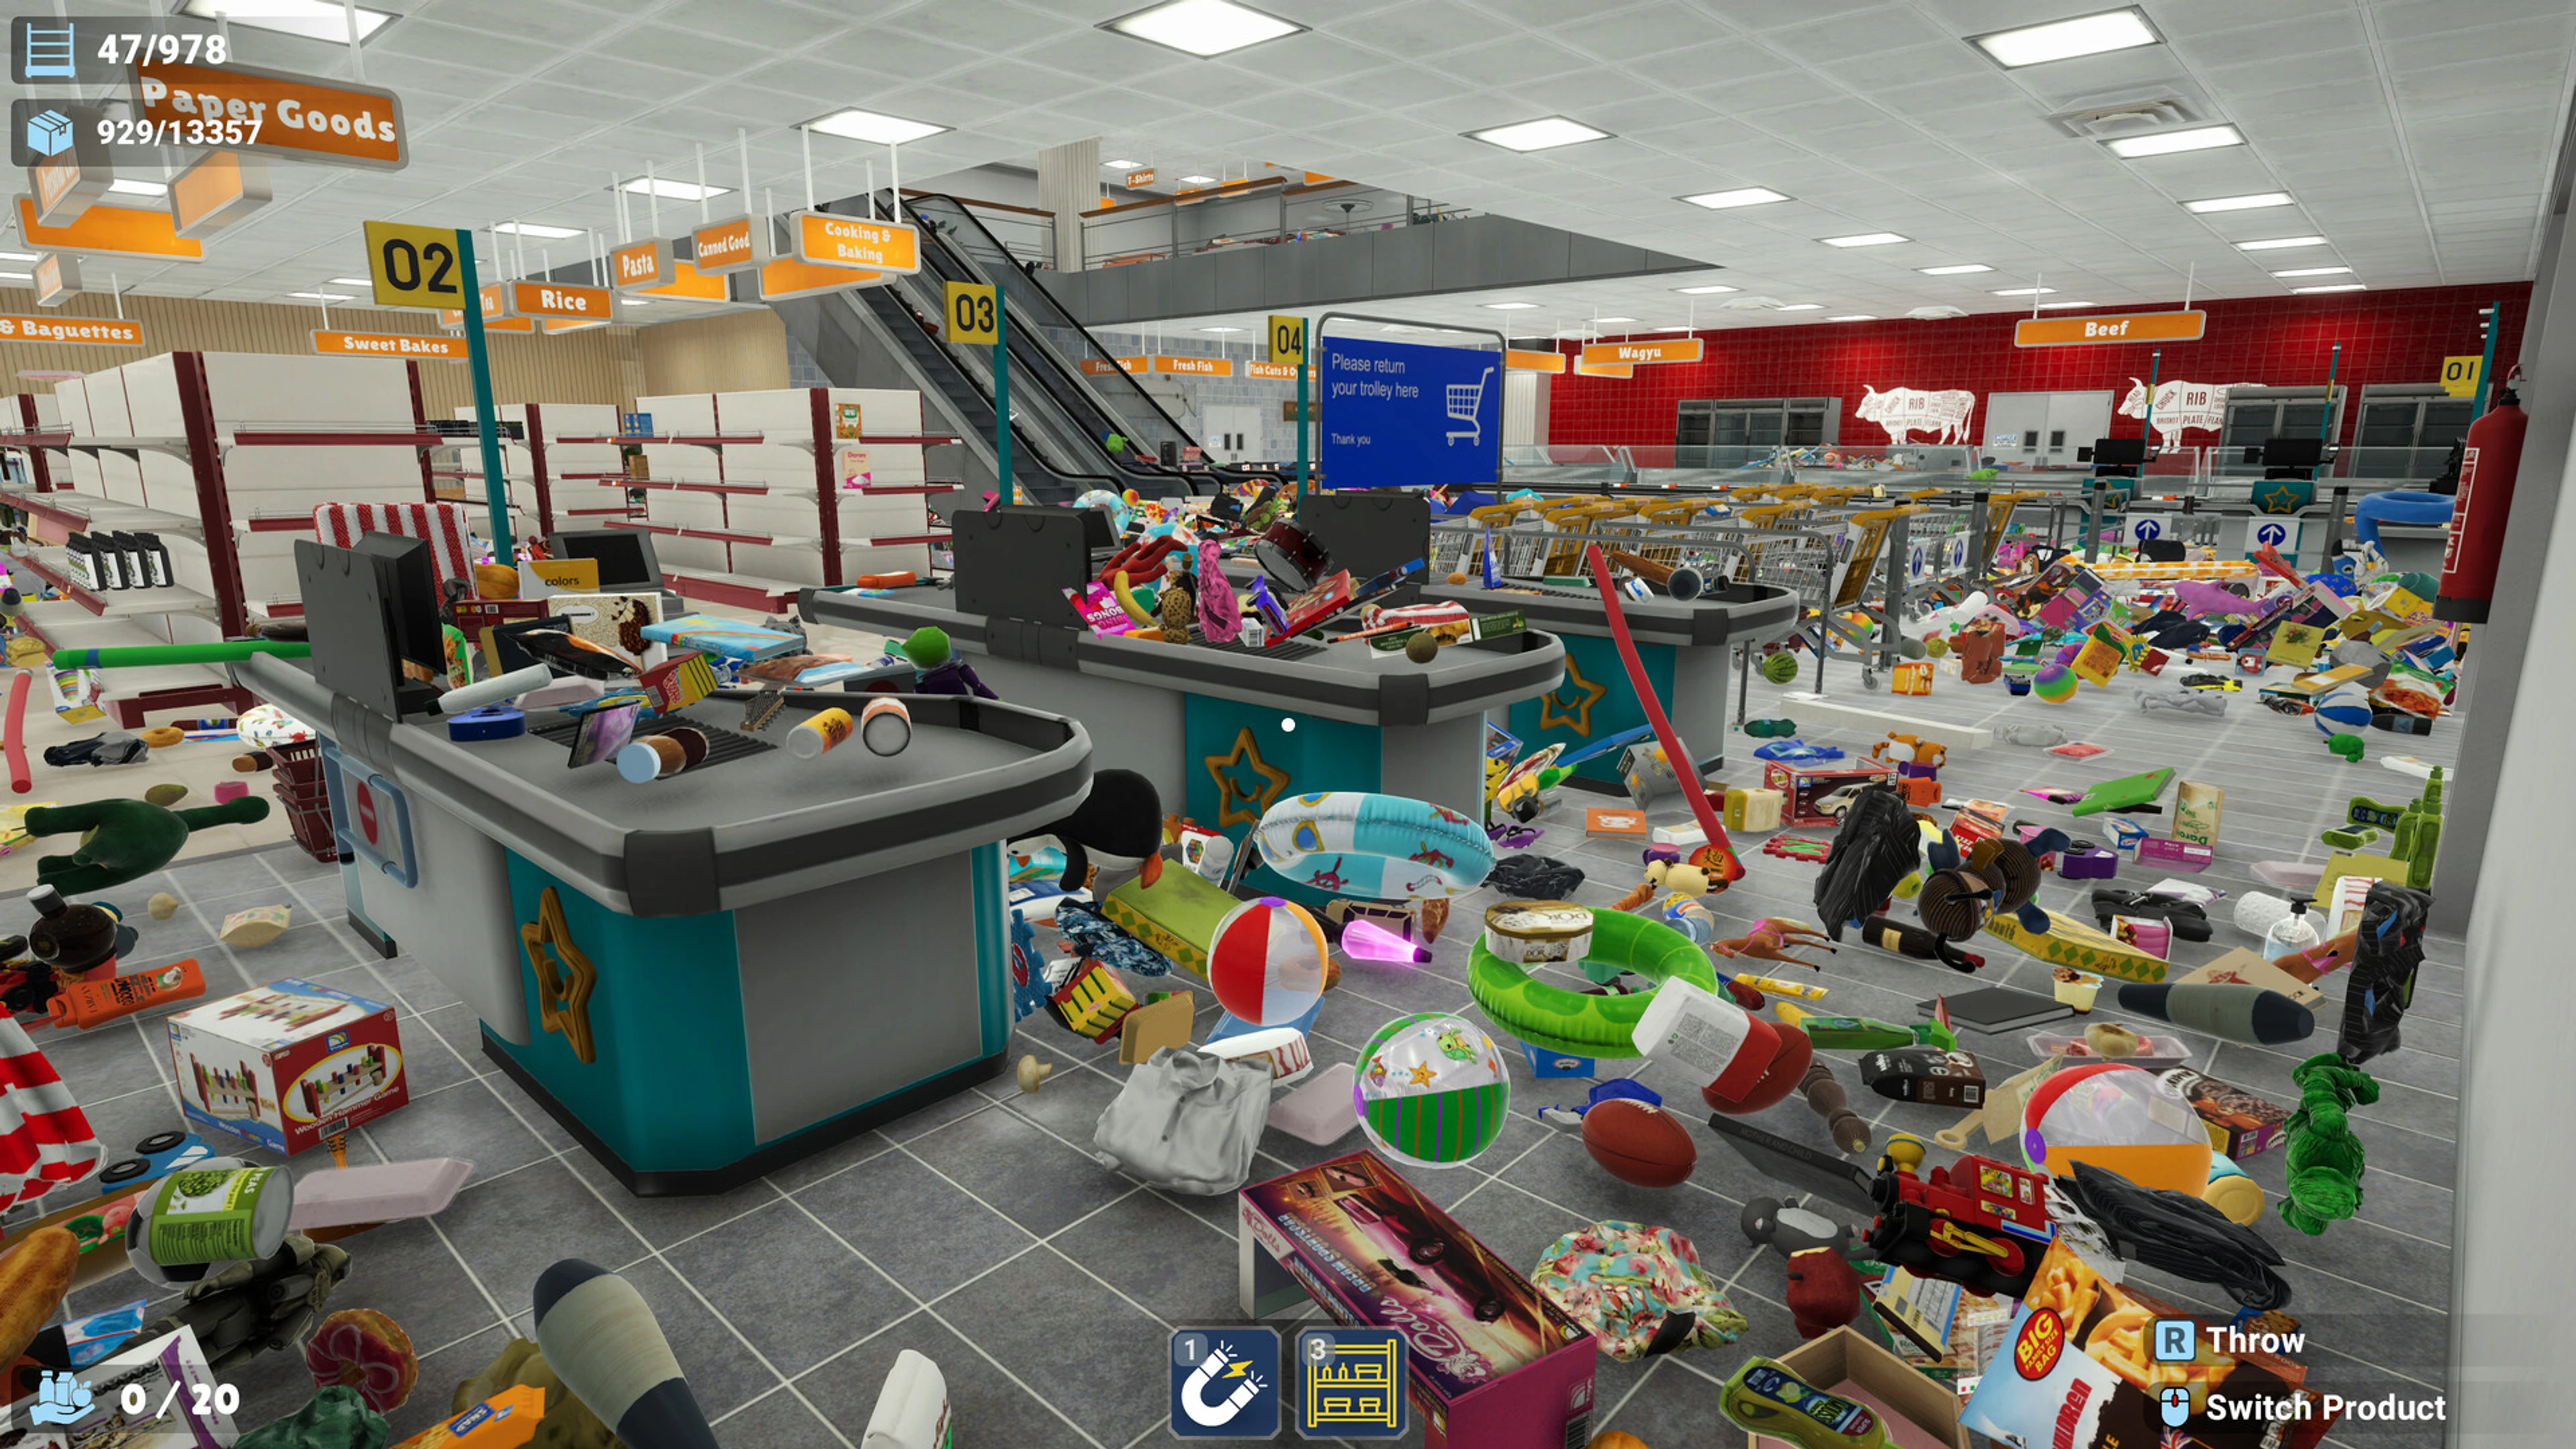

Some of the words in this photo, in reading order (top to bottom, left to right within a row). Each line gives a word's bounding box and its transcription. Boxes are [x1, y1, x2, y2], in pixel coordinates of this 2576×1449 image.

[140, 76, 266, 130] Paper
[276, 99, 396, 143] Goods
[1127, 172, 1154, 185] T-Shirts
[825, 222, 878, 244] Cooking
[881, 229, 891, 242] &
[698, 237, 727, 258] Canned
[729, 231, 750, 253] Good
[837, 244, 883, 264] Baking
[382, 238, 458, 294] 02
[622, 252, 655, 278] Pasta
[541, 289, 586, 311] Rice
[955, 293, 994, 333] 03
[21, 320, 133, 341] Baguettes
[2084, 321, 2129, 337] Beef
[343, 337, 396, 352] Sweet
[400, 339, 449, 355] Bakes
[1277, 325, 1301, 355] 04
[1332, 354, 1371, 373] Please
[1375, 359, 1405, 374] return
[1619, 346, 1661, 361] Wagyu
[1173, 360, 1195, 372] Fresh
[1197, 362, 1214, 372] Fish
[1332, 382, 1357, 398] your
[1360, 382, 1391, 400] trolley
[1395, 384, 1419, 398] here
[2155, 389, 2178, 410] CHUCK
[2186, 392, 2207, 406] RIB
[1909, 398, 1925, 410] RIB
[2183, 415, 2204, 425] PLATE
[1332, 433, 1353, 445] Thank
[1356, 436, 1371, 447] you
[545, 575, 580, 587] colors
[294, 1114, 333, 1136] Wooden
[334, 1099, 372, 1120] Hammer
[373, 1085, 400, 1102] Game
[244, 1170, 262, 1195] PEAS
[2018, 1313, 2053, 1362] BIG
[2025, 1344, 2046, 1371] FAMILY
[2045, 1330, 2059, 1346] SIZE
[2035, 1344, 2057, 1373] BAG
